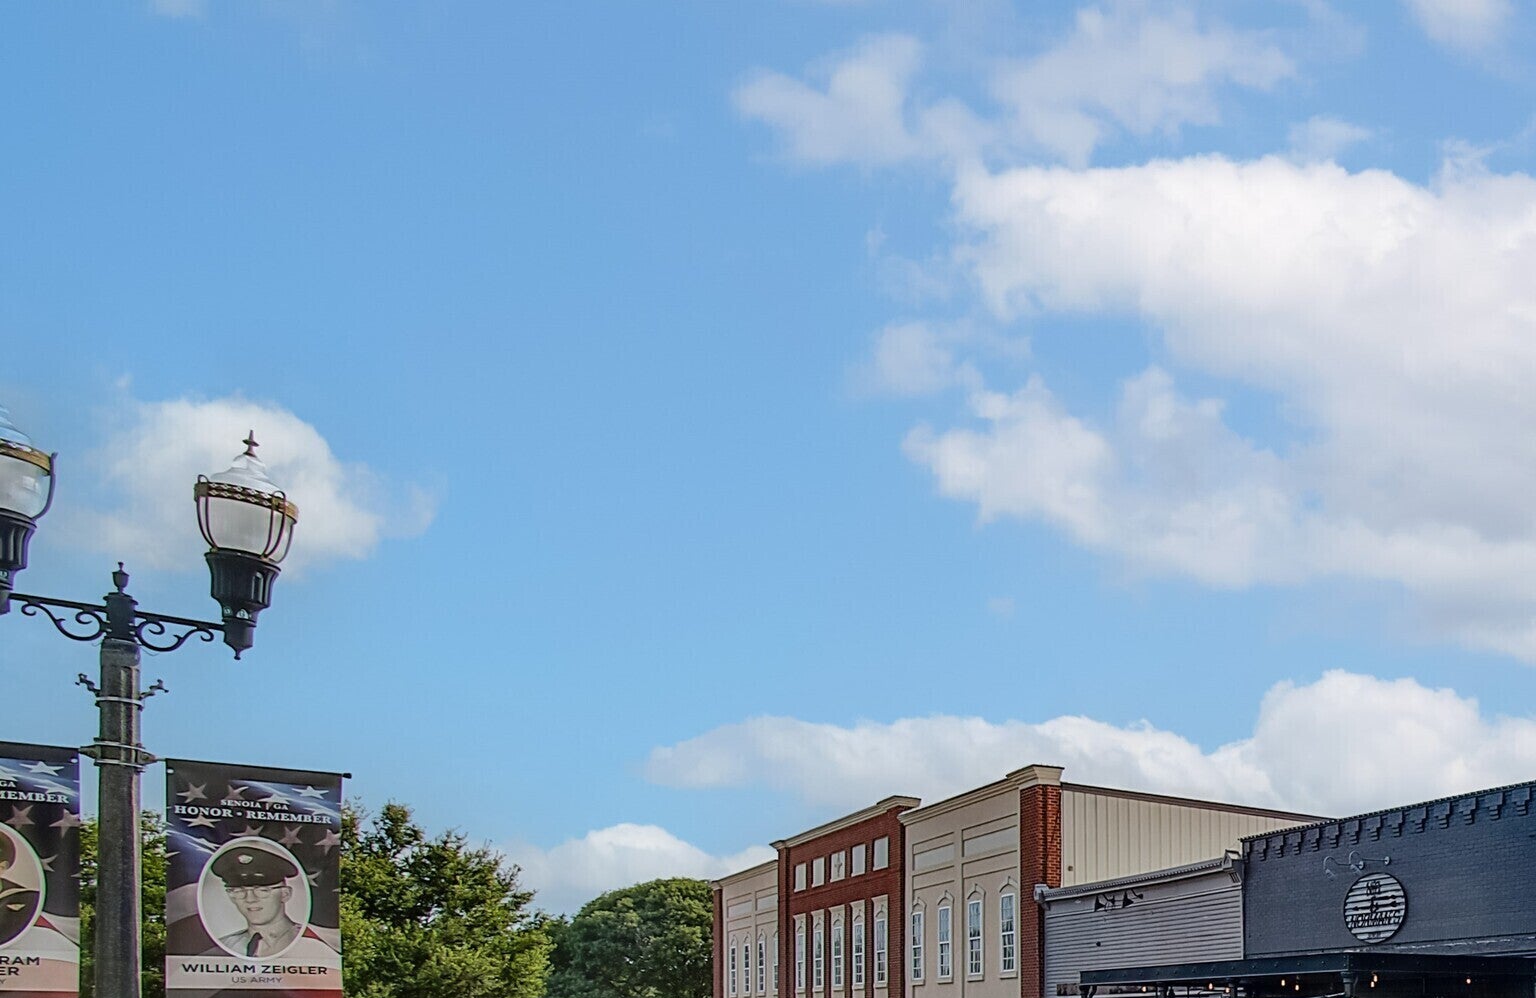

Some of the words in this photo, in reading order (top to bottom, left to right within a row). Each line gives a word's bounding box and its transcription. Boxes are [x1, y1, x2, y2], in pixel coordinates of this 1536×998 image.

[220, 799, 261, 809] SENOIA
[174, 805, 234, 818] HONOR
[245, 810, 332, 824] REMEMBER
[182, 963, 256, 974] WILLIAM
[261, 965, 328, 975] ZEIGLER
[232, 976, 246, 984] US
